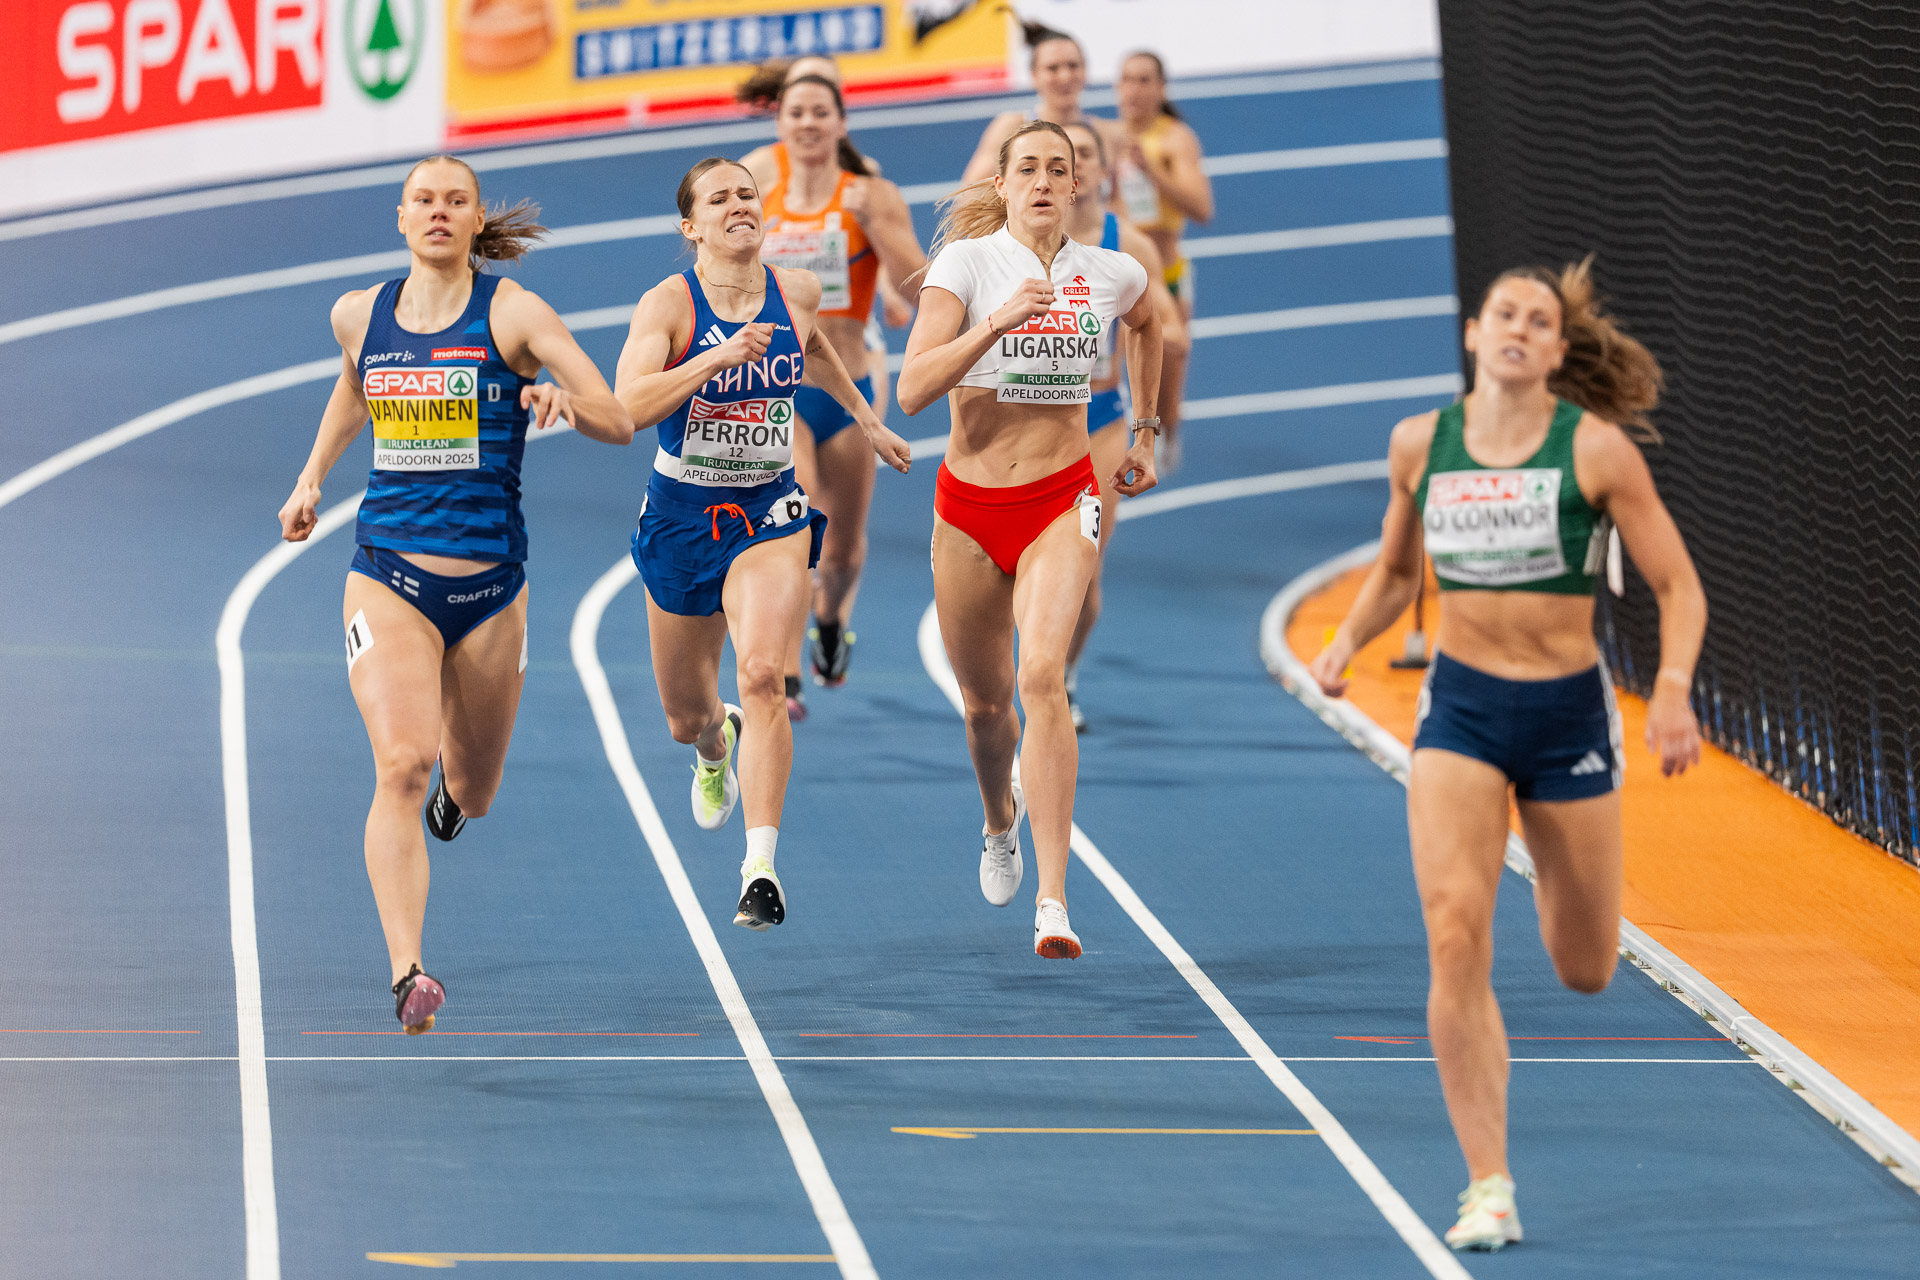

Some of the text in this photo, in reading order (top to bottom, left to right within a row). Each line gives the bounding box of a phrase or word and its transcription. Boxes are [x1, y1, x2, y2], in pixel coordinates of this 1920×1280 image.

[56, 0, 323, 124] SPAR
[1064, 287, 1088, 295] ORLEN
[1013, 313, 1077, 332] PAR
[433, 349, 487, 359] motonet
[1002, 336, 1098, 359] LIGARSKA
[364, 352, 403, 365] CRAFT
[1051, 360, 1059, 372] 5
[701, 352, 802, 394] RANCE
[1027, 375, 1050, 384] RUN
[367, 373, 443, 394] SPAR
[487, 383, 501, 403] D
[1002, 388, 1089, 400] APELDOORN 2025
[368, 399, 473, 422] VANNINEN
[692, 402, 764, 420] SPAR
[412, 425, 420, 436] 1
[686, 420, 789, 447] PERRON
[392, 439, 412, 449] RUN
[728, 446, 744, 458] 12
[376, 453, 475, 466] APELDOORN 2025
[707, 458, 730, 469] RUN
[683, 469, 756, 483] APELDOORN
[447, 588, 492, 604] CRAFT
